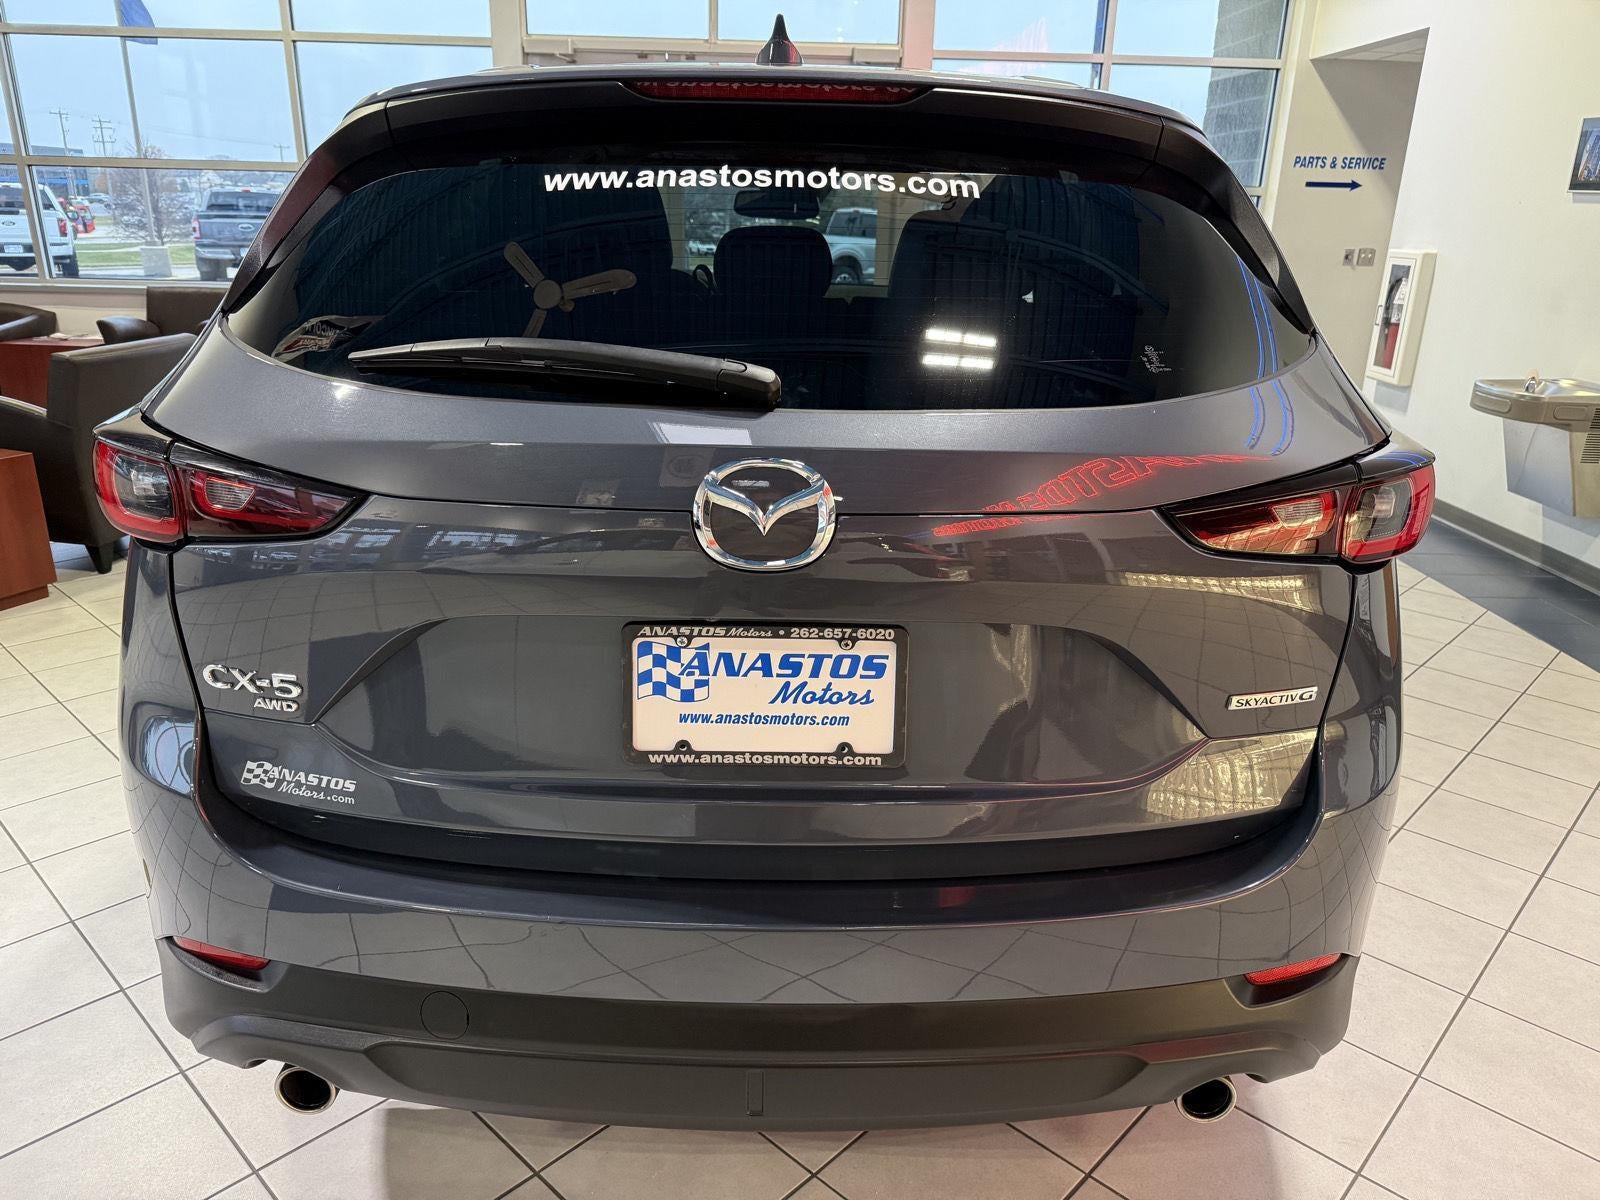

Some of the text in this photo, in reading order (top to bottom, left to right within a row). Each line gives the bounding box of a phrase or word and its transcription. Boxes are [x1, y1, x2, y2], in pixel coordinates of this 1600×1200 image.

[1293, 156, 1387, 170] PARTS & SERVICE
[543, 164, 981, 199] www.anastosmotors.com
[637, 626, 895, 640] ANASTOS Motors 262-657-6020
[678, 651, 889, 679] ANASTOS
[202, 663, 303, 698] CX-5
[768, 680, 875, 705] Motors
[253, 697, 298, 712] AWD
[679, 712, 850, 726] www.anastosmotors.com
[648, 753, 882, 766] www.anastosmotors.com
[266, 765, 357, 792] ANASTOS
